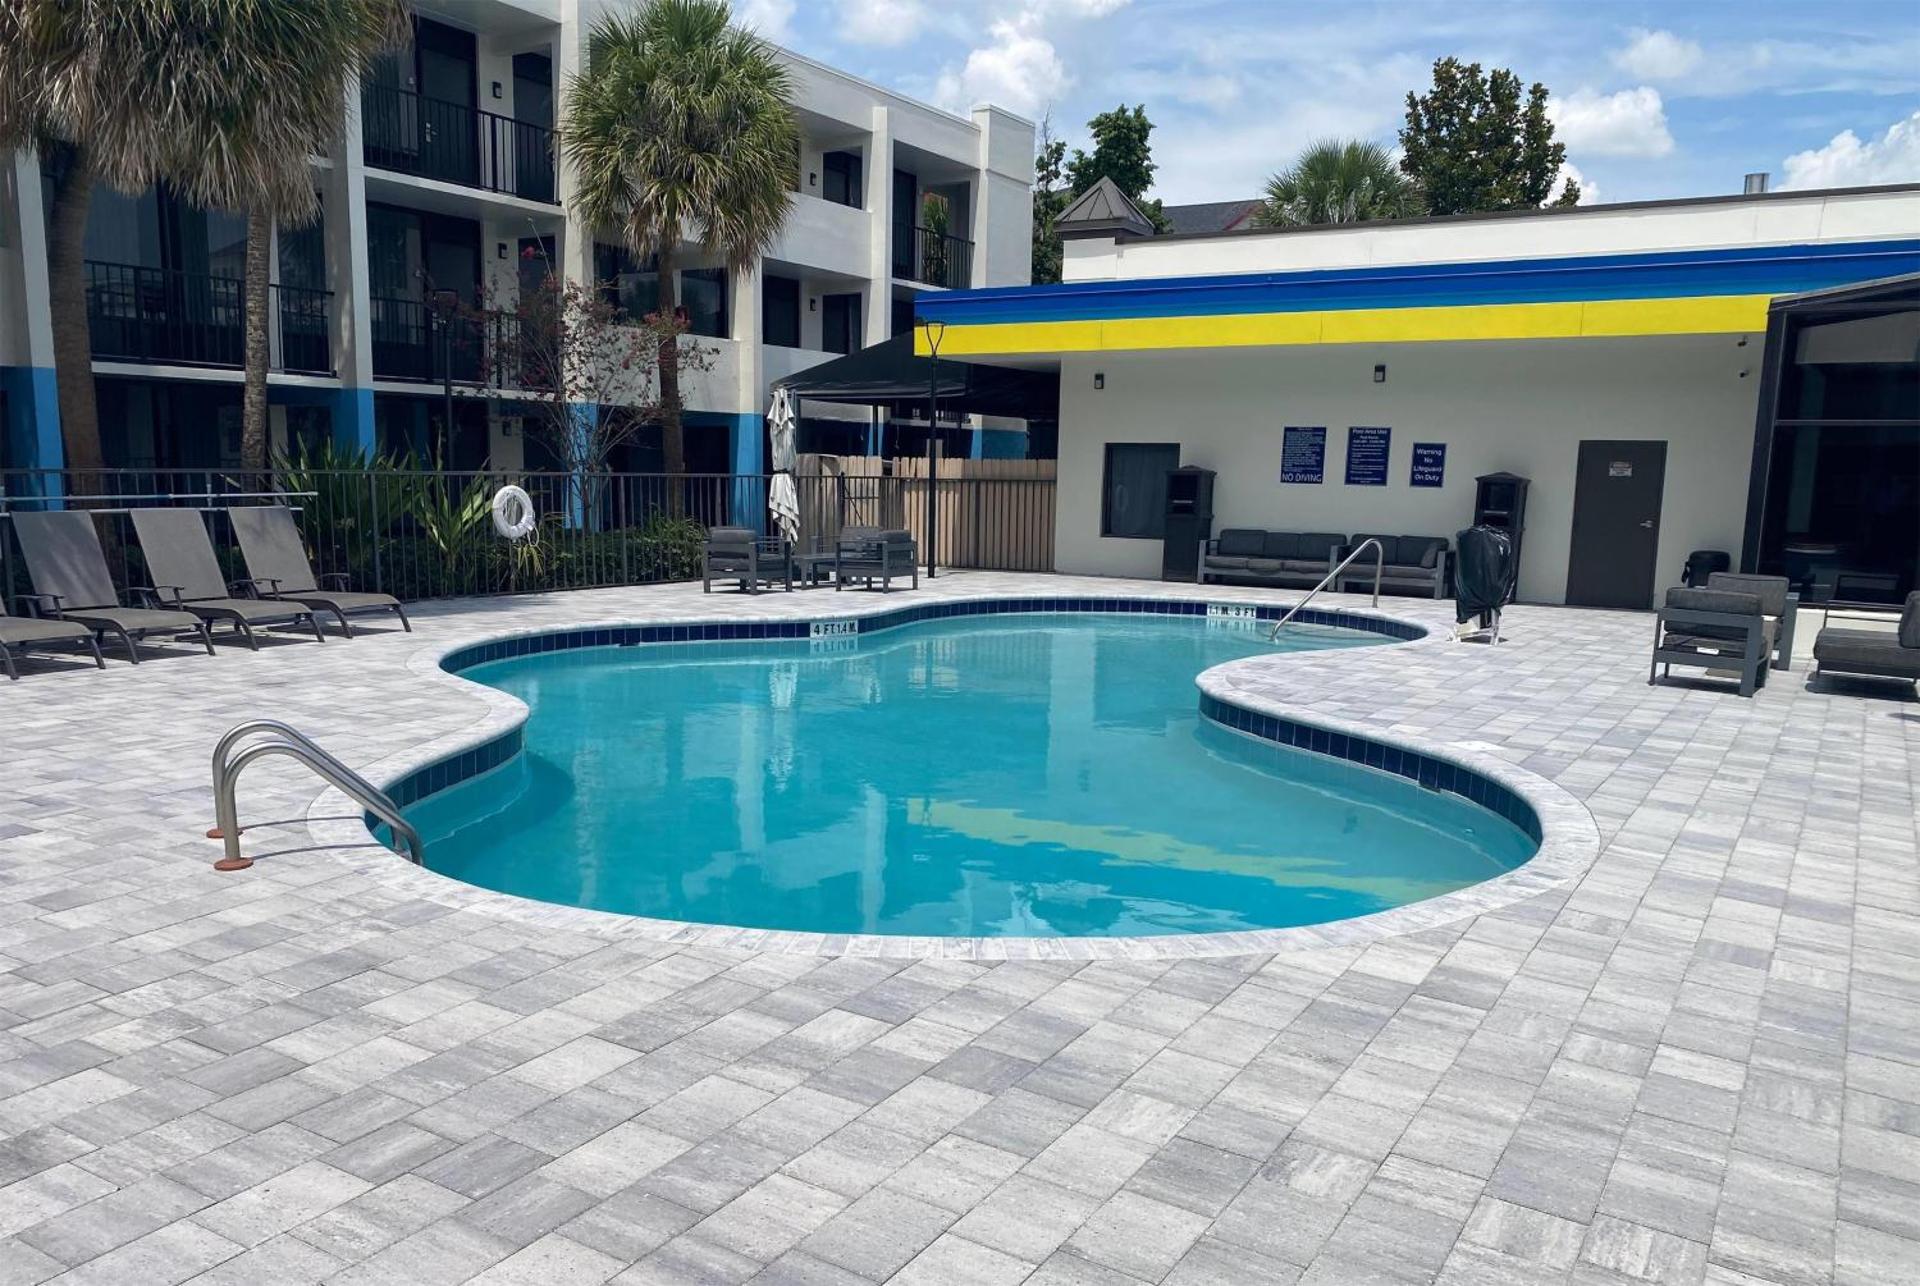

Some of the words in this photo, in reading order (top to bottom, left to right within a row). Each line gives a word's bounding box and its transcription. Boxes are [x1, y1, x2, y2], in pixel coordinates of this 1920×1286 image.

[1416, 448, 1442, 456] Warning
[1413, 465, 1442, 473] Lifeguard
[1282, 472, 1294, 481] NO
[1295, 473, 1322, 482] DIVING
[1425, 474, 1440, 482] Duty
[1234, 606, 1241, 617] 3
[813, 623, 820, 635] 4
